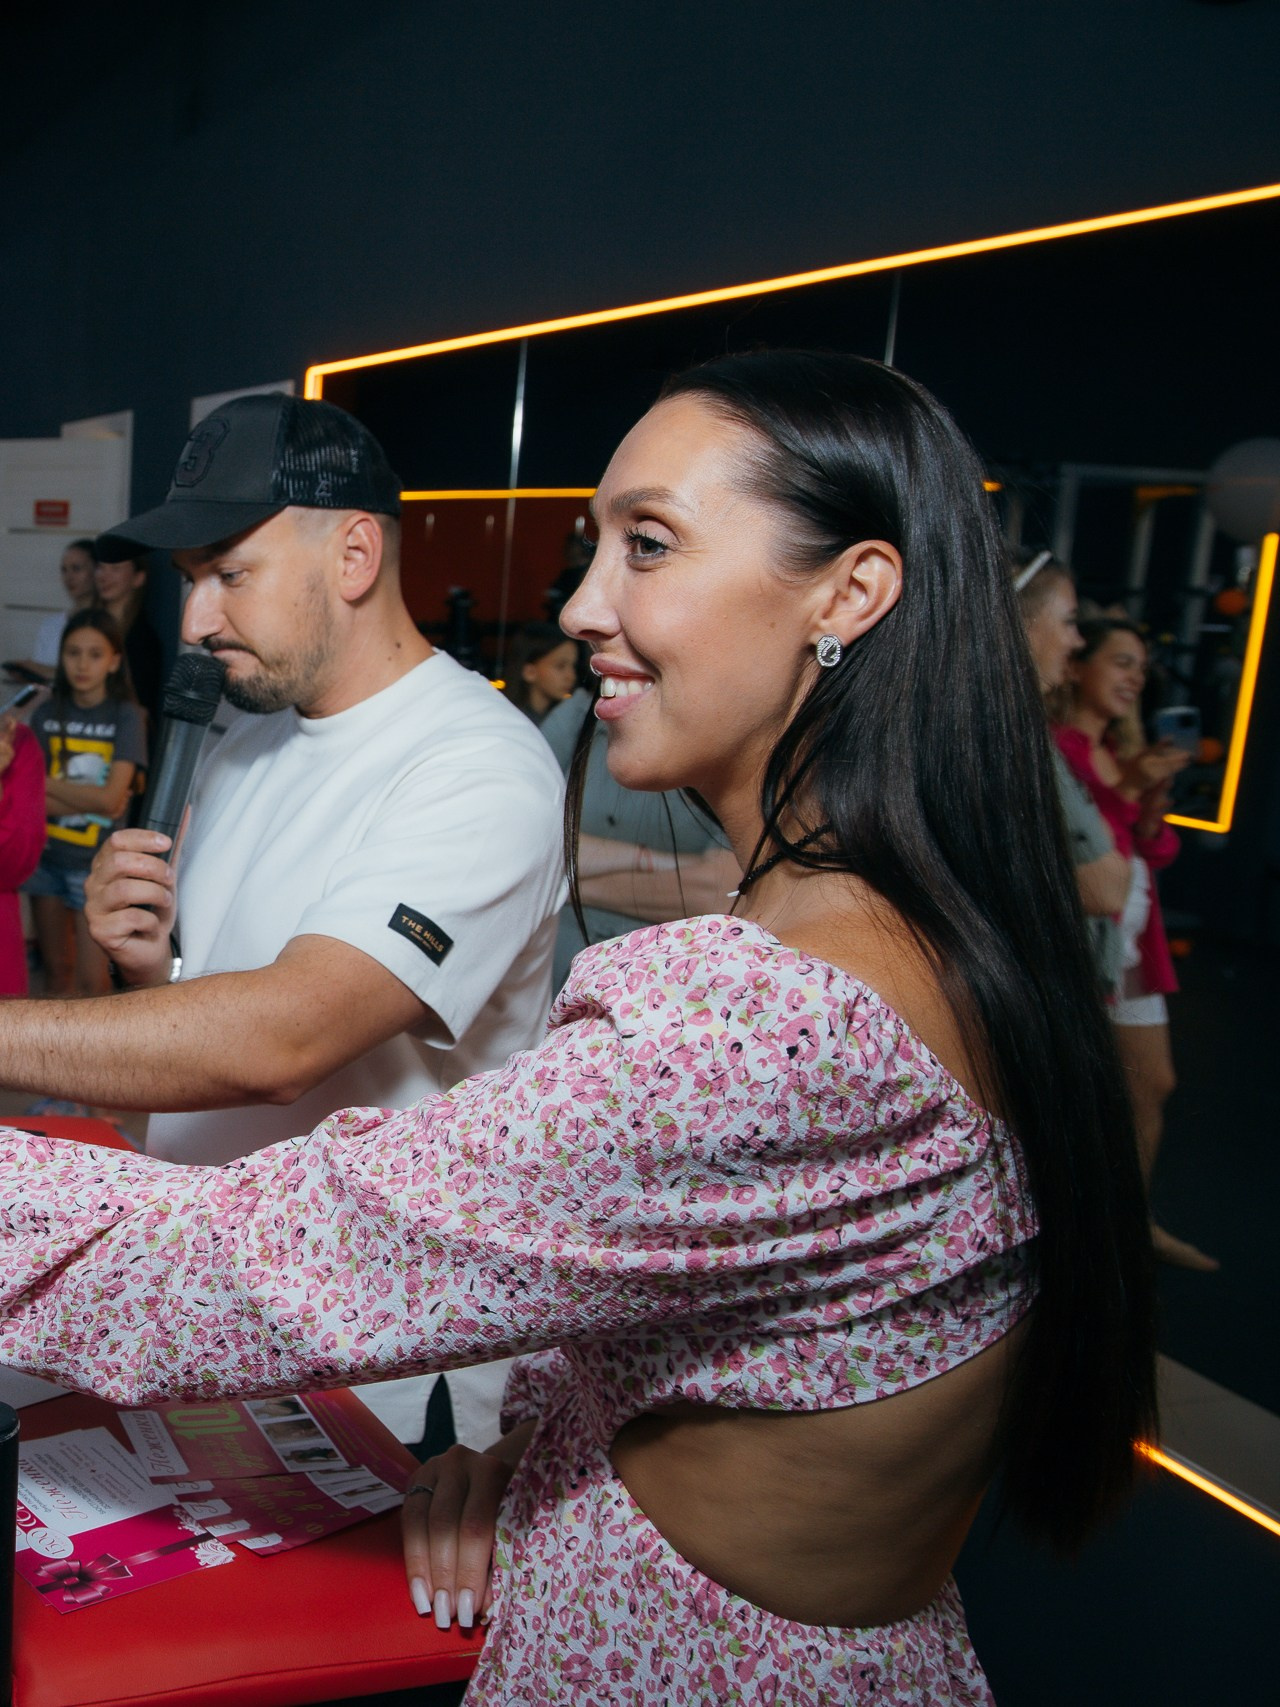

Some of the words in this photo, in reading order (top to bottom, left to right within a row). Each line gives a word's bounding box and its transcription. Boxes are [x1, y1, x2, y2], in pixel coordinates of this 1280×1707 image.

[401, 915, 423, 933] THE
[423, 930, 445, 953] HILLS
[167, 1408, 248, 1440] 10
[132, 1413, 176, 1474] Неженка
[31, 1530, 66, 1555] 1500
